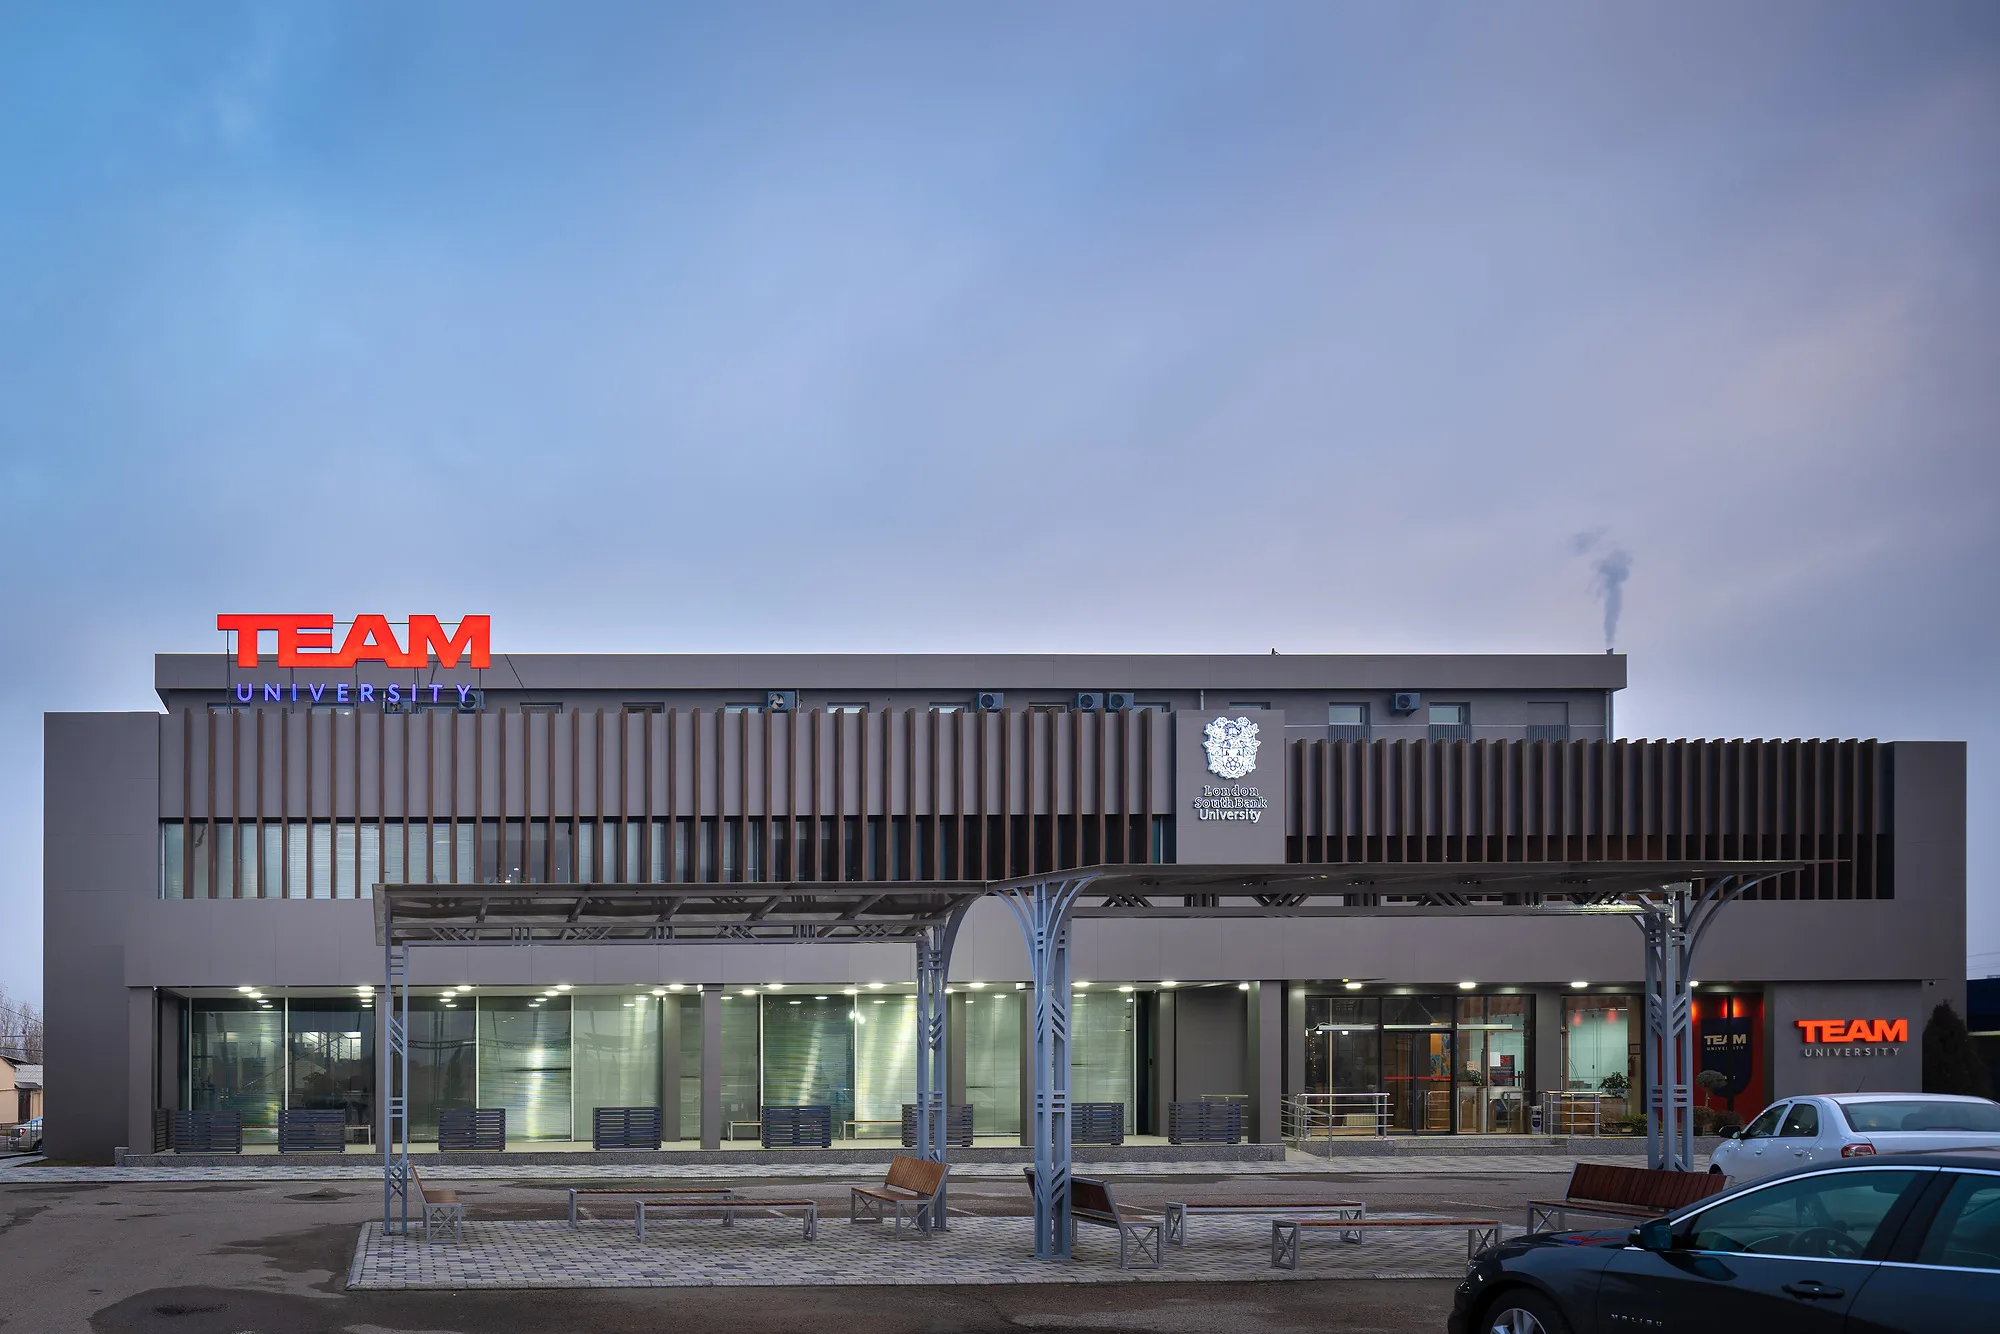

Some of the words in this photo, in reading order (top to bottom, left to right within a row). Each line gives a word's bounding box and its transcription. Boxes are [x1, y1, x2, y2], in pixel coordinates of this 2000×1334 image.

[217, 614, 490, 668] TEAM
[236, 683, 472, 702] UNIVERSITY
[1203, 784, 1259, 797] London
[1199, 809, 1262, 823] University
[1795, 1019, 1908, 1043] TEAM
[1804, 1048, 1900, 1057] UNIVERSITY
